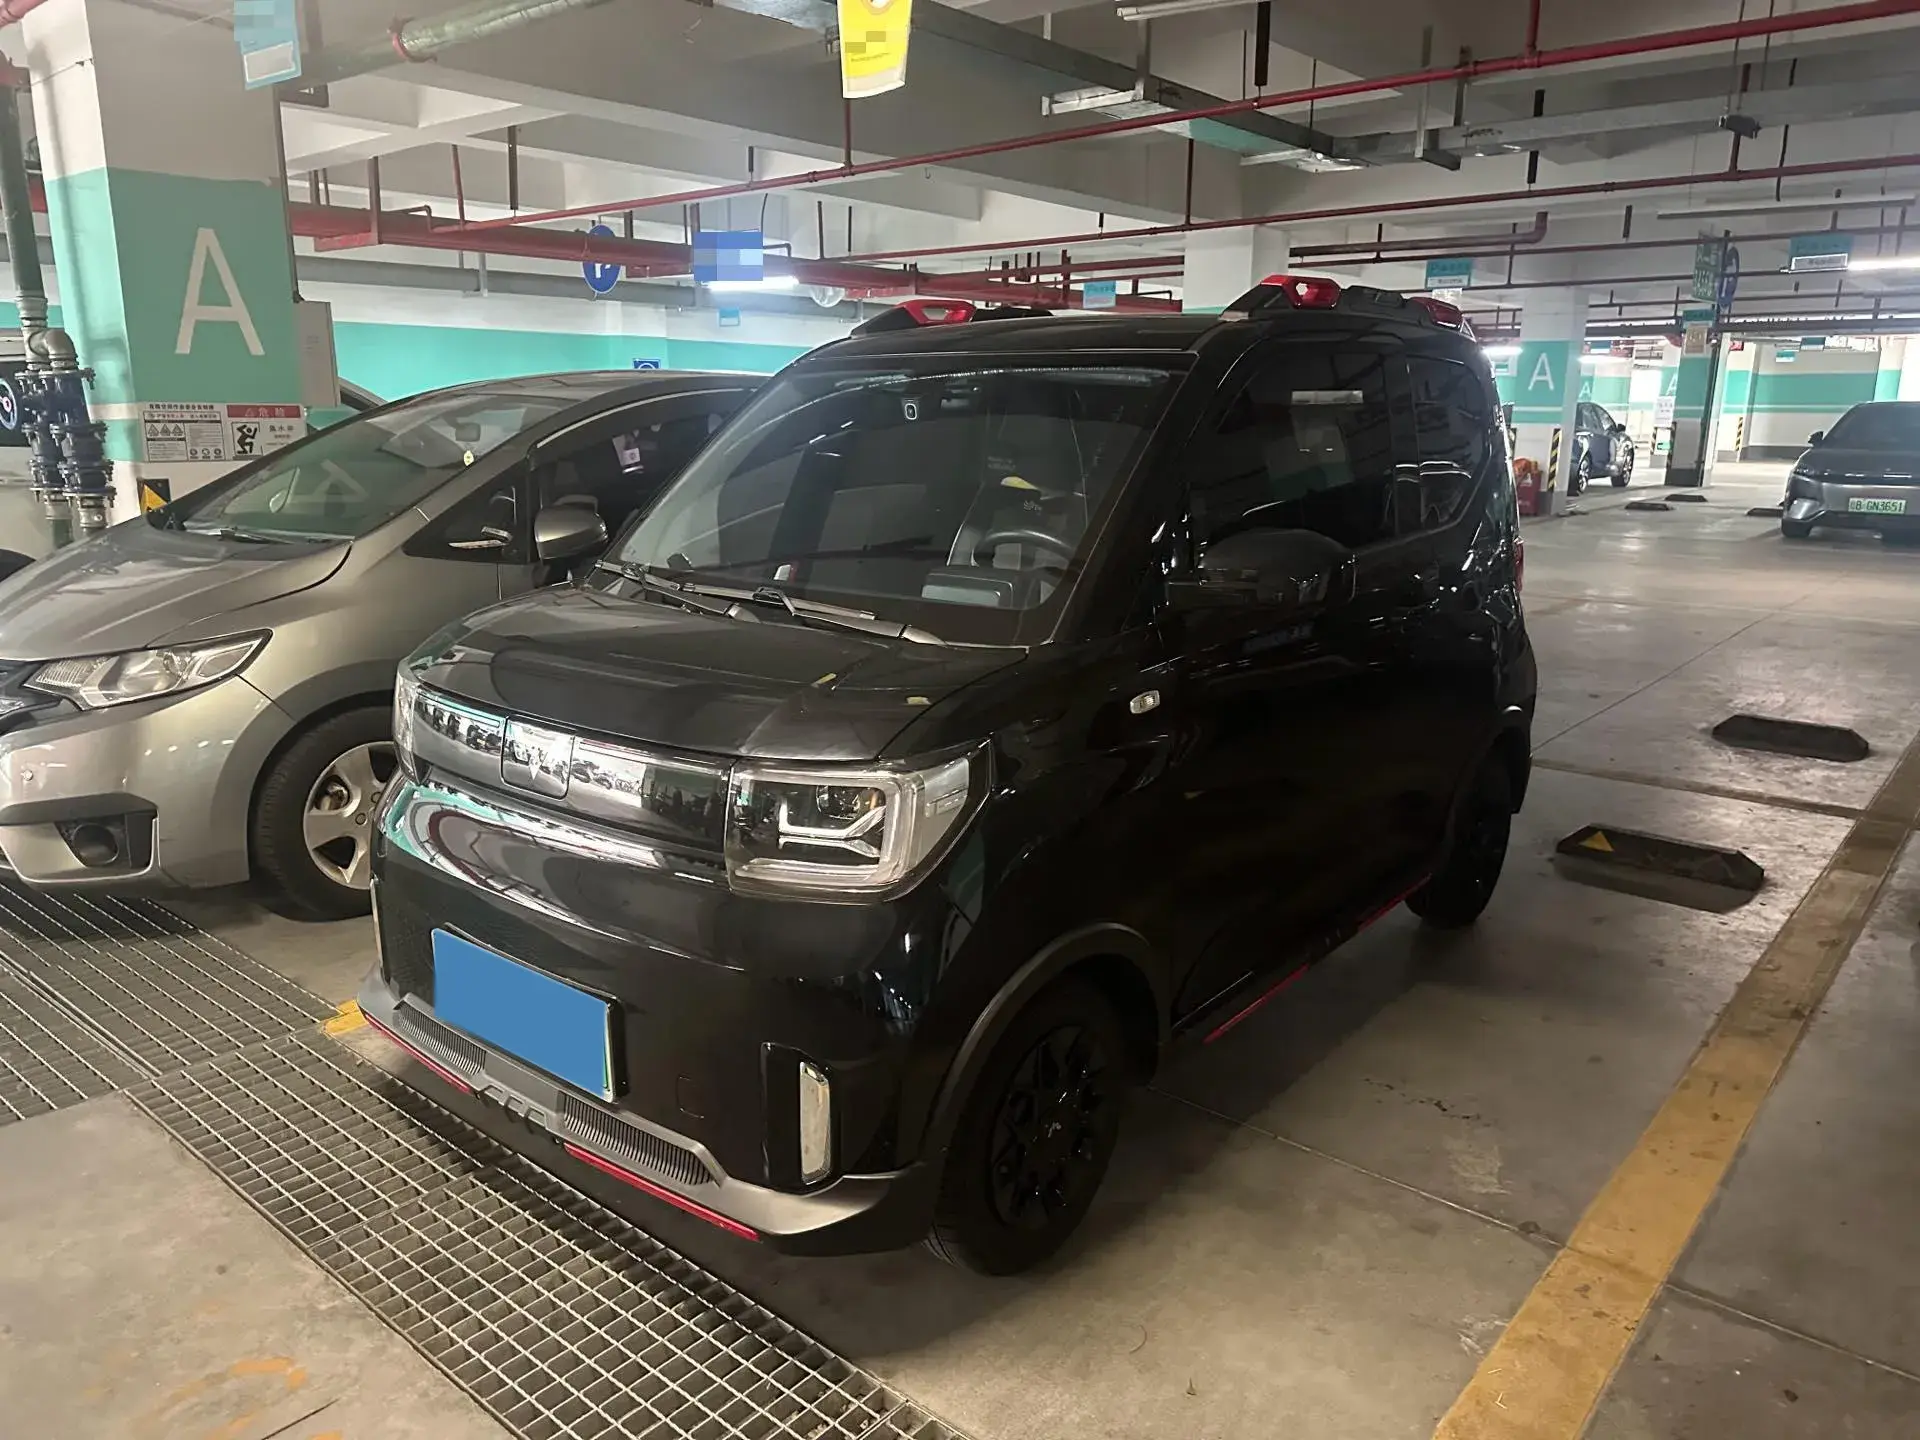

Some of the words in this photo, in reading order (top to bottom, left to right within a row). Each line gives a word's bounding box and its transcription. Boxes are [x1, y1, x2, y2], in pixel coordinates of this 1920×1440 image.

[175, 226, 265, 356] A
[1528, 352, 1554, 391] A
[1578, 381, 1591, 399] A
